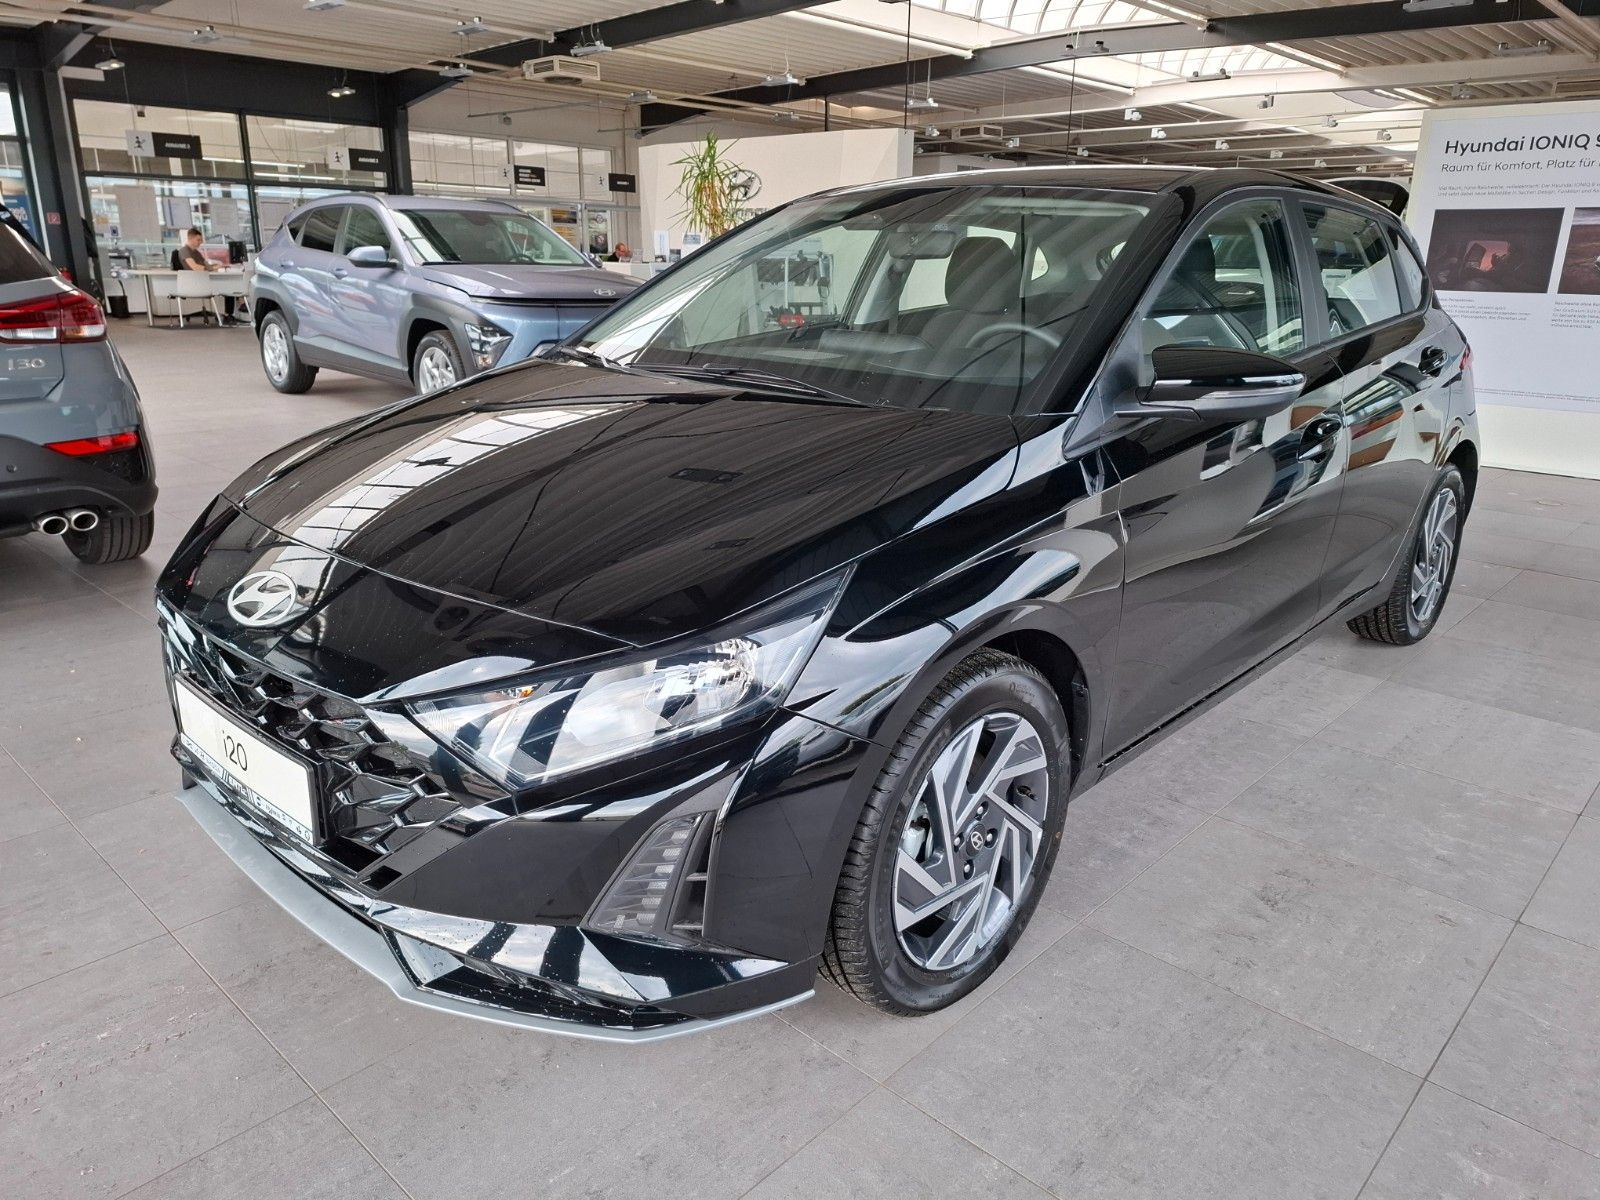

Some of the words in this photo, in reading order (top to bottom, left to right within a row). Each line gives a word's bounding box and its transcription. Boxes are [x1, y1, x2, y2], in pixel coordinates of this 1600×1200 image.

[1444, 136, 1525, 157] Hyundai
[1529, 133, 1591, 151] IONIQ
[1441, 163, 1474, 173] Raum
[1477, 161, 1492, 171] für
[1494, 160, 1543, 171] Komfort,
[1546, 159, 1576, 169] Platz
[1579, 157, 1597, 168] für
[222, 730, 248, 771] i20
